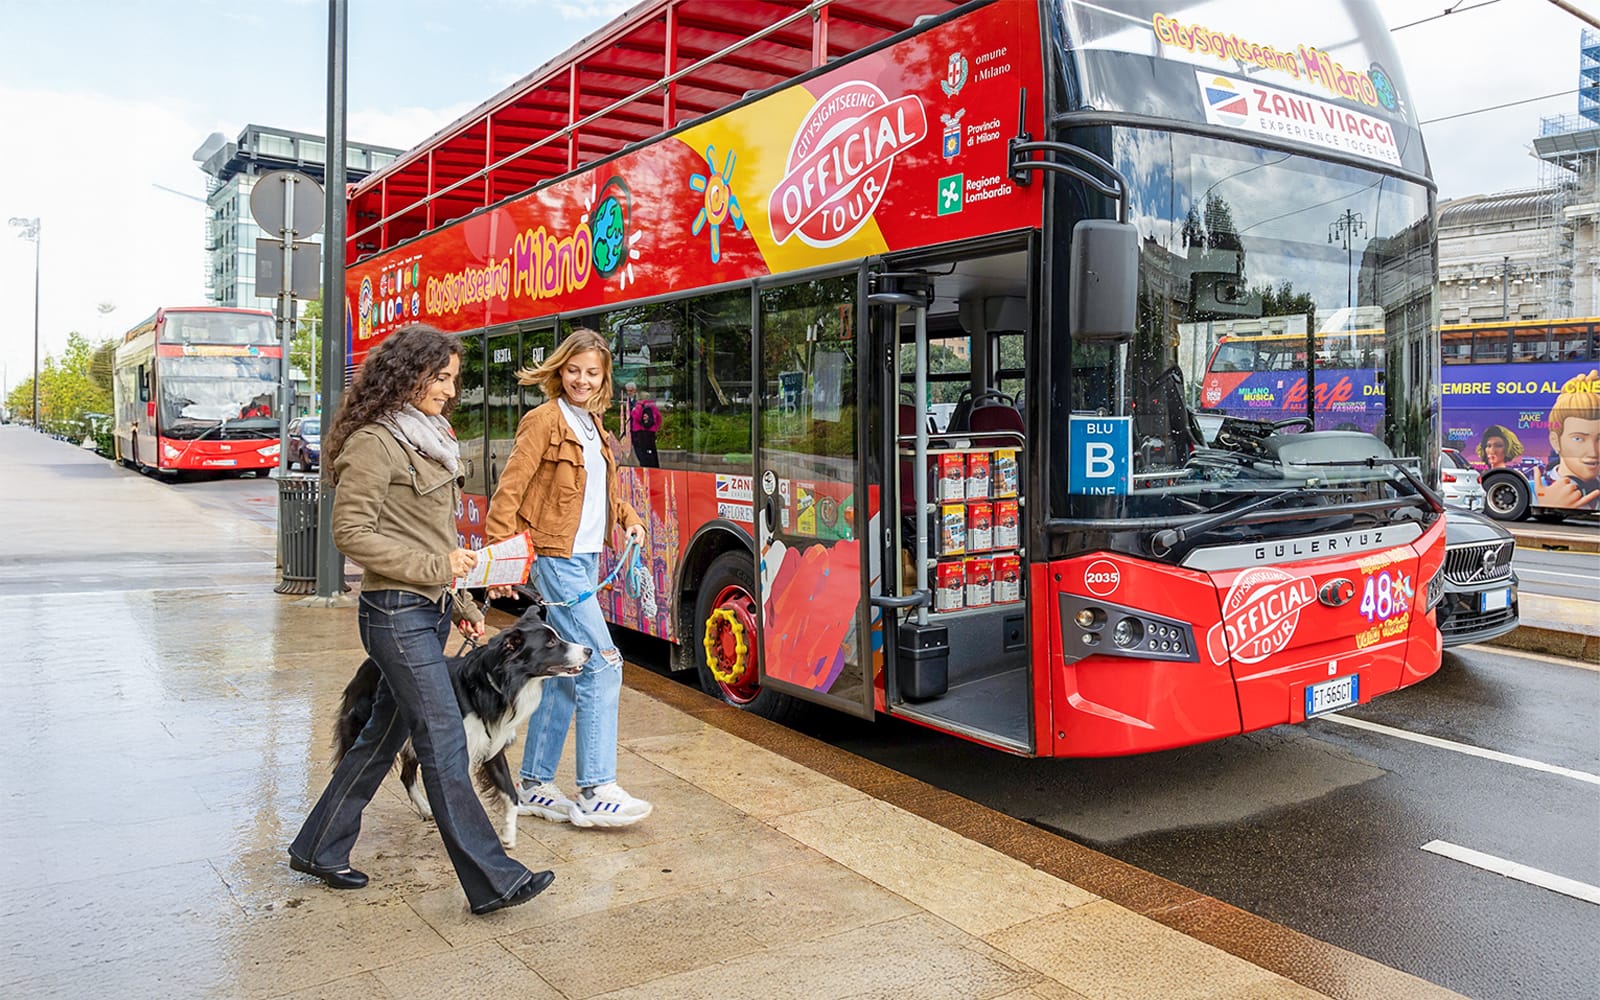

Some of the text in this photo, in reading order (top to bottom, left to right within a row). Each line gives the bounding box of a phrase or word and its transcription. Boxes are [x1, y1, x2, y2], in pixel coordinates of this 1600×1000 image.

[980, 64, 1011, 81] Milano
[1298, 44, 1379, 107] Milano
[797, 93, 876, 159] CITYSIGHTSEEING
[967, 118, 1001, 136] Provincia
[1253, 89, 1394, 146] ZANI VIAGGI
[967, 131, 1000, 147] di Milano
[1260, 118, 1397, 160] EXPERIENCE TOGETHER
[783, 106, 916, 225] OFFICIAL
[966, 174, 1001, 191] Regione
[965, 183, 1012, 204] Lombardia
[821, 176, 881, 234] TOUR
[514, 222, 593, 301] Milano
[1238, 387, 1270, 395] MILANO
[1441, 381, 1491, 395] EMBRE
[1496, 381, 1538, 394] SOLO
[1540, 381, 1561, 394] AL
[1565, 380, 1600, 394] CINE
[1332, 405, 1367, 413] FASHION
[1518, 414, 1542, 422] JAKE
[1086, 423, 1113, 434] BLU
[1518, 421, 1530, 429] LA
[1086, 442, 1115, 478] B
[1087, 572, 1118, 583] 2035
[1360, 570, 1392, 623] 48
[1221, 581, 1311, 652] OFFICIAL
[1253, 620, 1293, 656] TOUR
